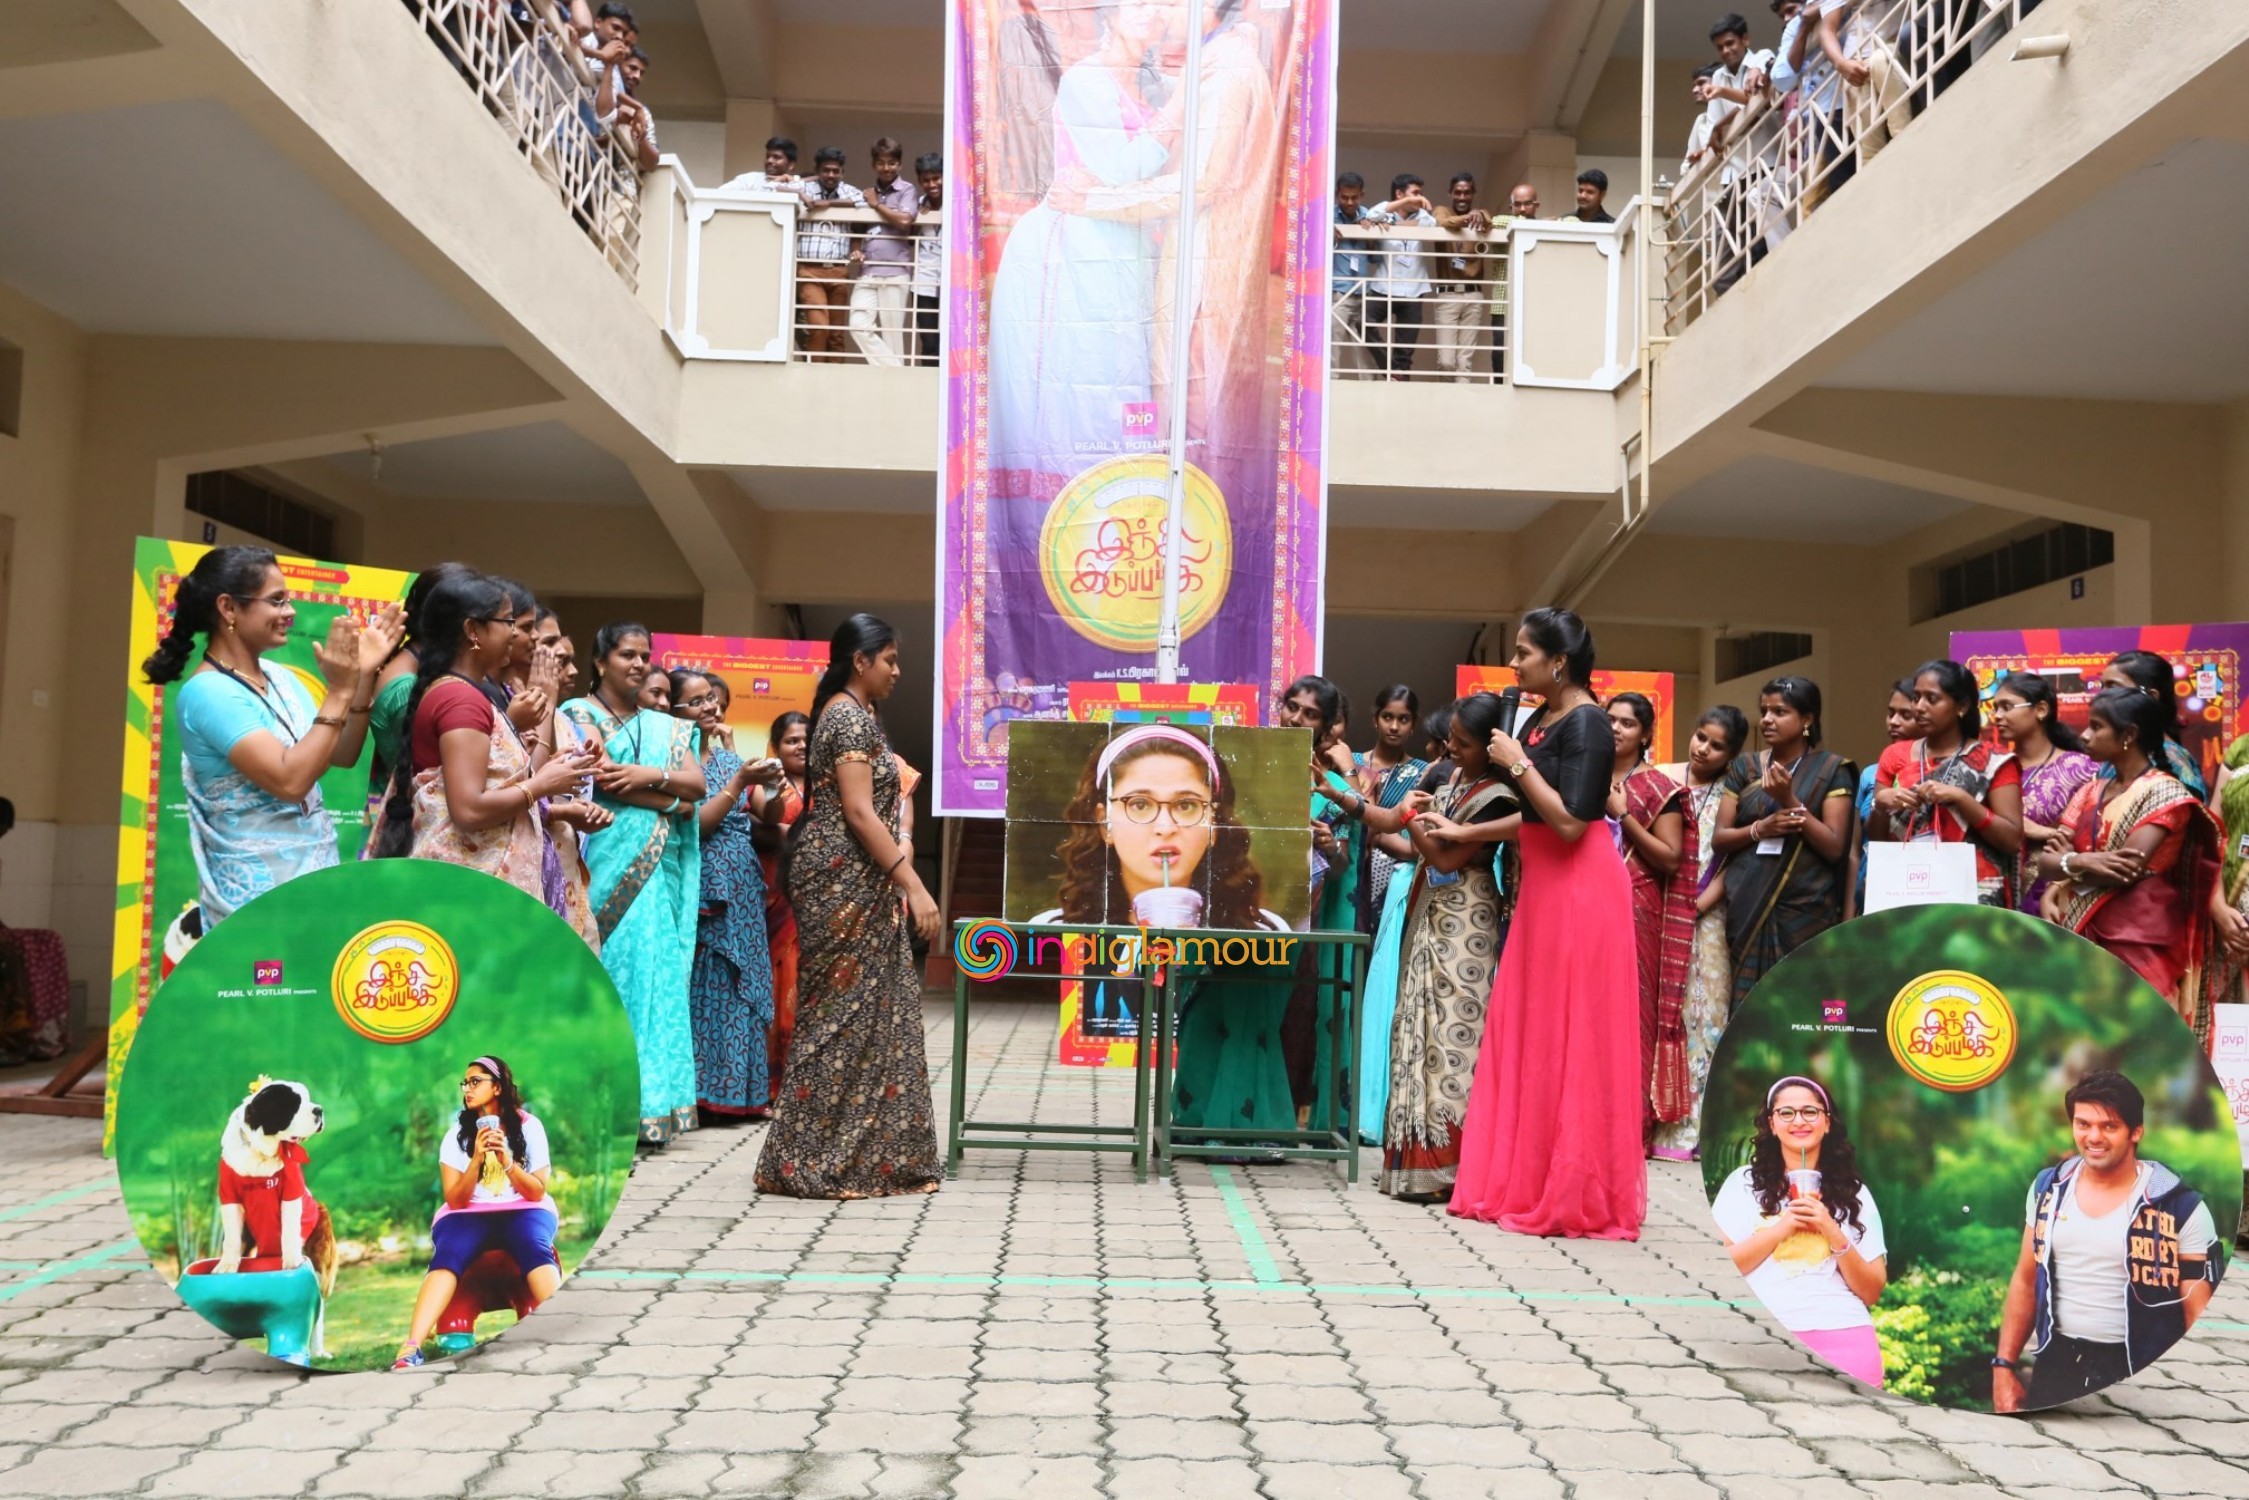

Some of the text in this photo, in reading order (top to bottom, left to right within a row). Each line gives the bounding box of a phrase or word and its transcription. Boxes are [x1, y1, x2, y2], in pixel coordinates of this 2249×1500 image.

[1126, 412, 1154, 427] pvp
[1074, 441, 1109, 451] PEARL
[1125, 439, 1169, 450] POTLUR
[2056, 657, 2109, 665] BIGGEST
[1909, 872, 1928, 882] pvp
[257, 968, 279, 979] pvp
[217, 989, 245, 998] PEARL
[256, 988, 292, 996] POTLURI
[1824, 1007, 1843, 1016] pvp
[1791, 1023, 1814, 1031] PEARL
[1823, 1024, 1855, 1032] POTLURI
[2221, 1034, 2244, 1047] pvp
